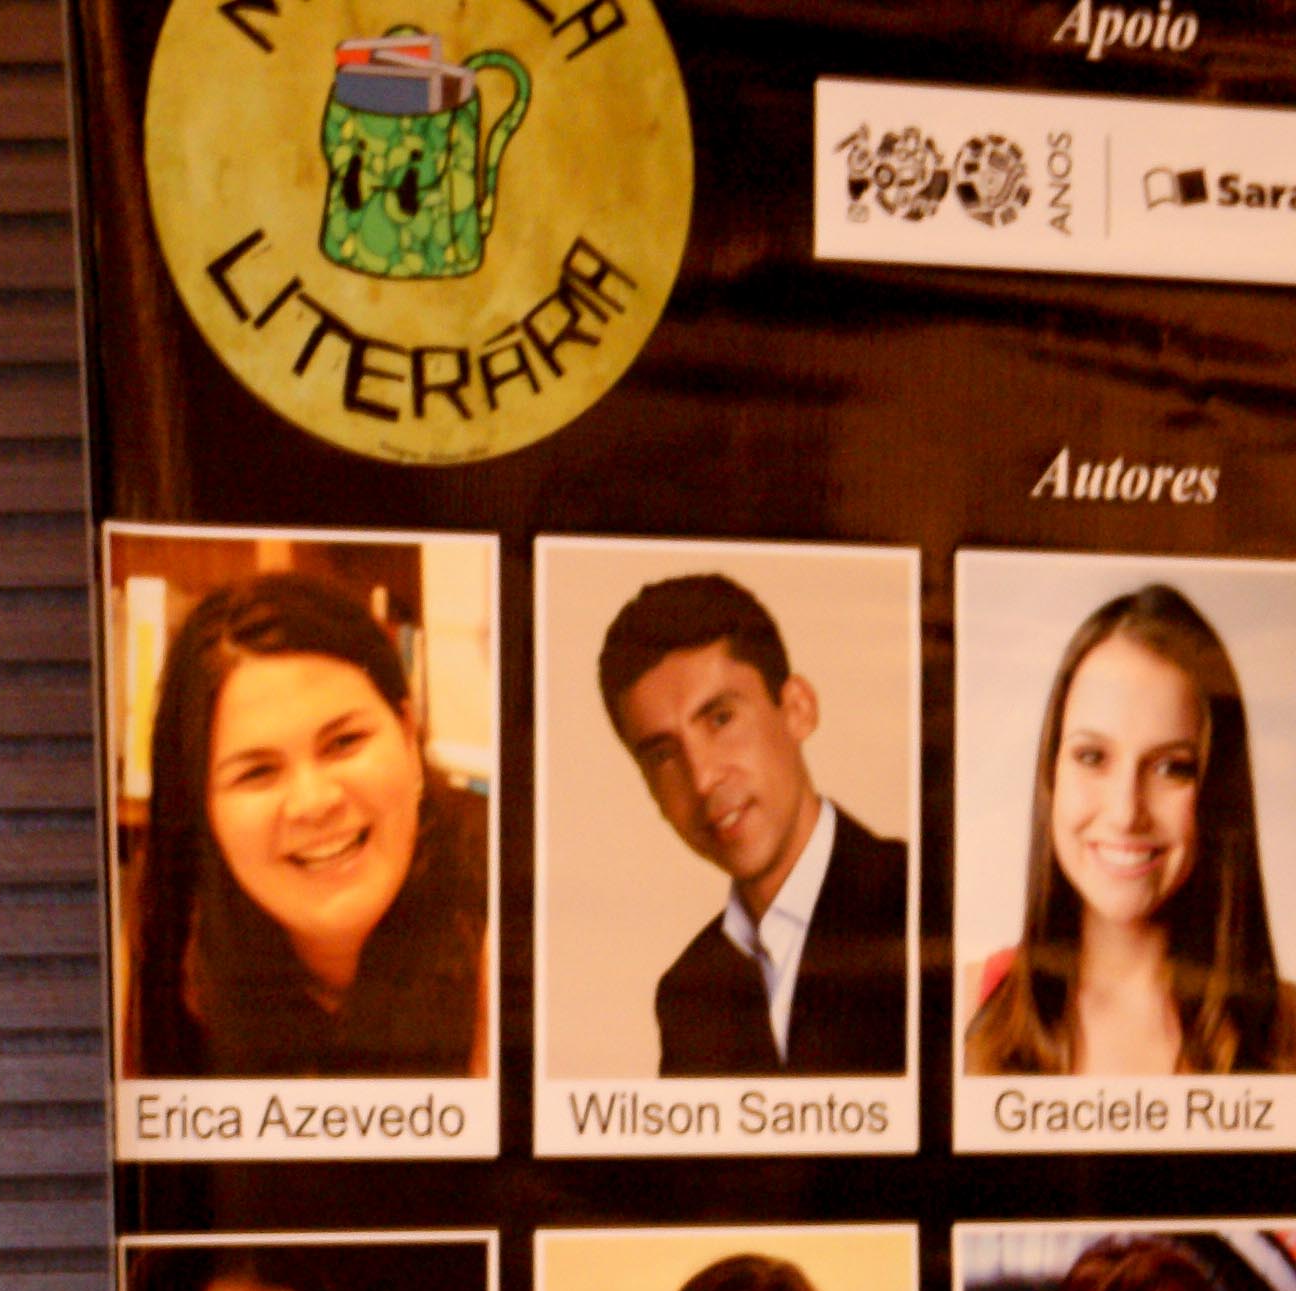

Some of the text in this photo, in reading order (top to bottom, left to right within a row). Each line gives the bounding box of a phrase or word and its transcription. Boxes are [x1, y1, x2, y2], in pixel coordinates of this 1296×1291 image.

[1053, 0, 1200, 62] Apoio
[1045, 131, 1073, 236] ANOS
[1217, 172, 1296, 211] Sar
[1030, 445, 1220, 503] Autores
[136, 1093, 465, 1140] Erica Azevedo
[570, 1089, 890, 1136] Wilson Santos
[994, 1088, 1274, 1132] Graciele Ruiz
